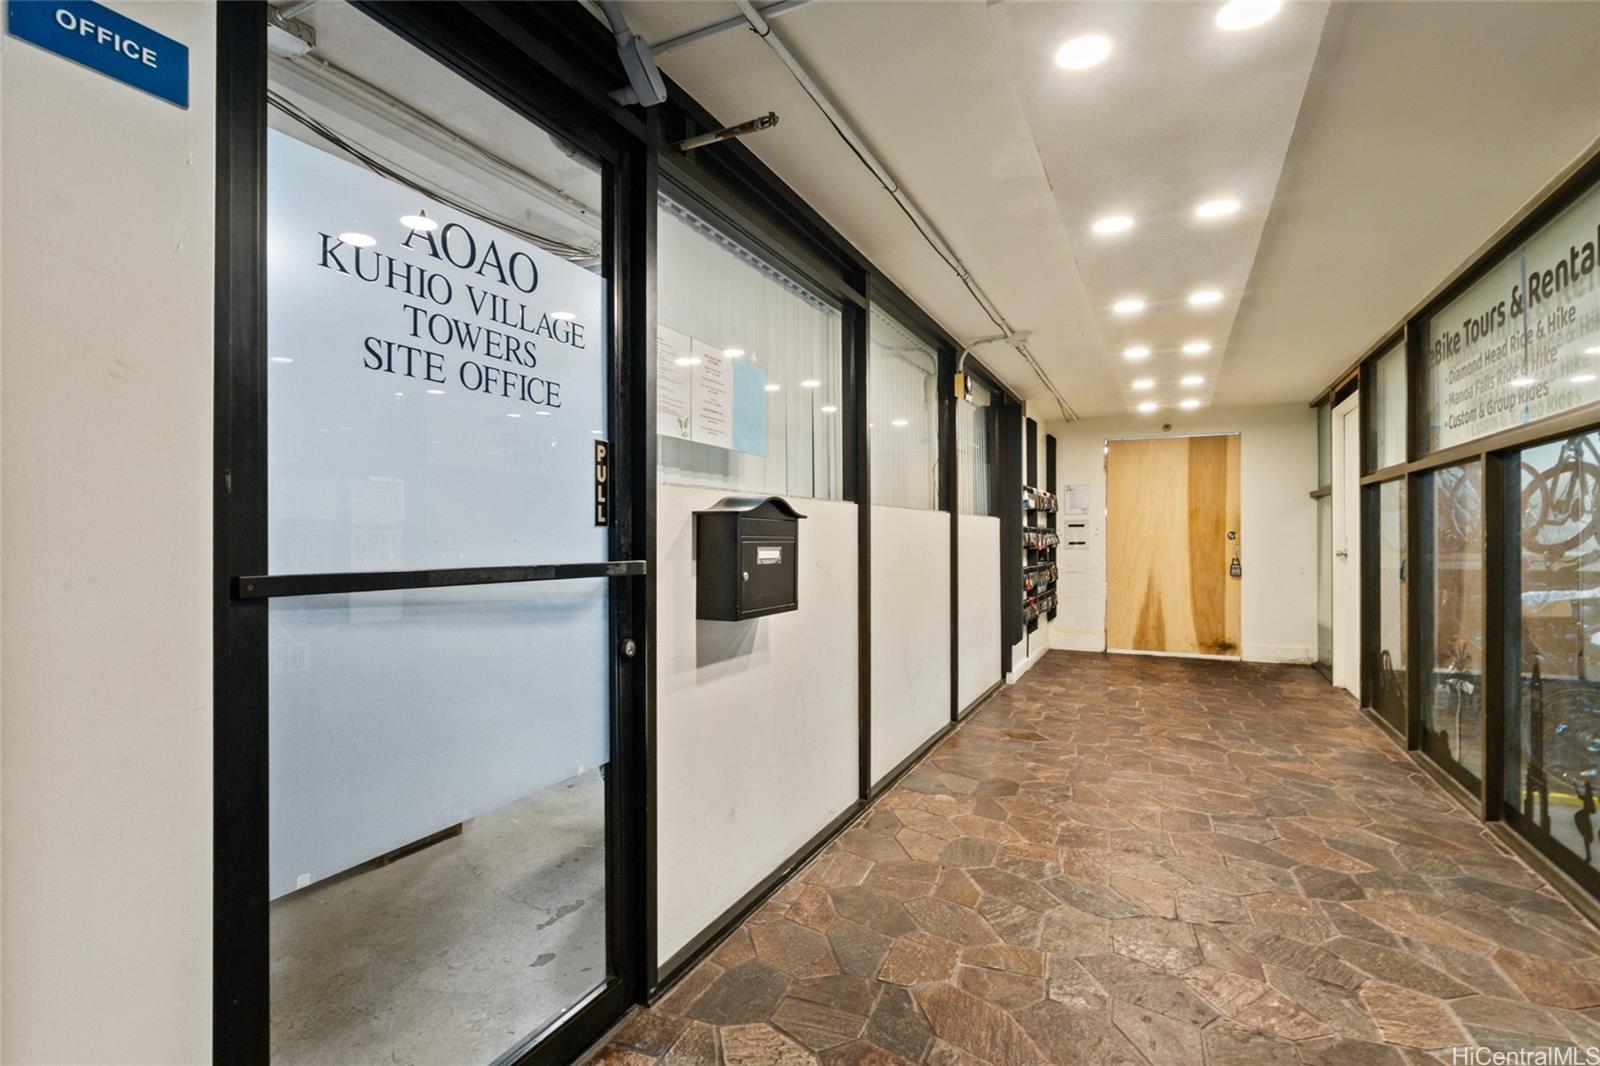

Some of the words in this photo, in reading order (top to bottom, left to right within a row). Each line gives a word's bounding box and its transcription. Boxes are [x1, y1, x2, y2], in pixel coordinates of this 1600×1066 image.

[55, 8, 158, 69] OFFICE
[400, 209, 538, 294] AOAO
[317, 231, 453, 305] KUHIO
[465, 283, 586, 350] VILLAGE
[1463, 300, 1506, 347] Tours
[1510, 284, 1523, 319] &
[403, 303, 537, 369] TOWERS
[1448, 352, 1483, 385] Diamond
[1484, 338, 1508, 367] Head
[1510, 328, 1534, 354] Ride
[1536, 319, 1546, 341] &
[1547, 305, 1577, 335] Hike
[363, 336, 447, 384] SITE
[459, 360, 562, 409] OFFICE
[1448, 408, 1478, 429] Custom
[1479, 402, 1486, 419] &
[1487, 394, 1517, 416] Group
[1518, 380, 1550, 405] Rides
[1475, 373, 1495, 398] Falls
[1496, 361, 1519, 385] Ride
[1531, 345, 1558, 372] Hike
[596, 444, 607, 523] PULL
